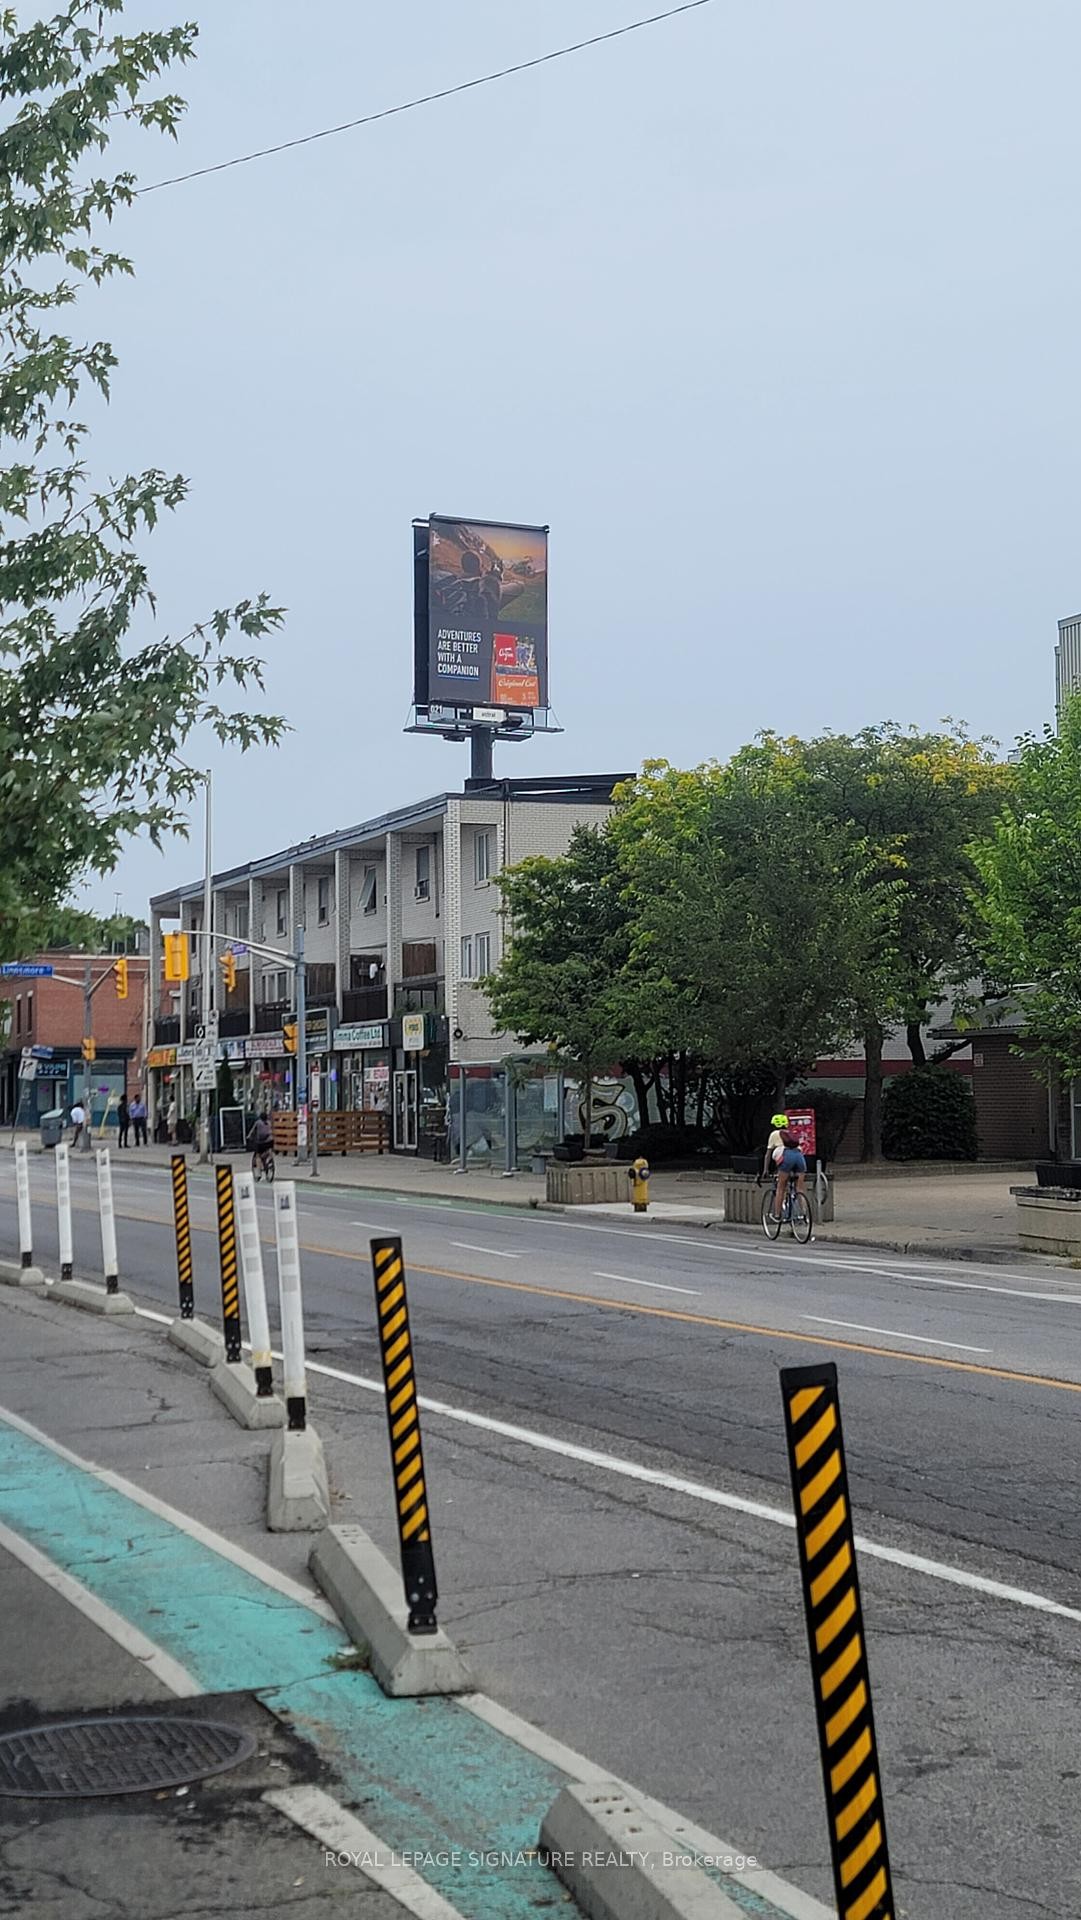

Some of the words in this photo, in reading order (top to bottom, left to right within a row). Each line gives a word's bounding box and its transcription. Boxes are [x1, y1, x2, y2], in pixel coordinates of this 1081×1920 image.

[437, 629, 482, 642] ADVENTURES
[437, 641, 451, 652] ARE
[452, 642, 479, 654] BETTER
[437, 652, 455, 663] WITH
[456, 654, 462, 664] A
[437, 663, 479, 677] COMPANION
[352, 1028, 370, 1041] Coffee
